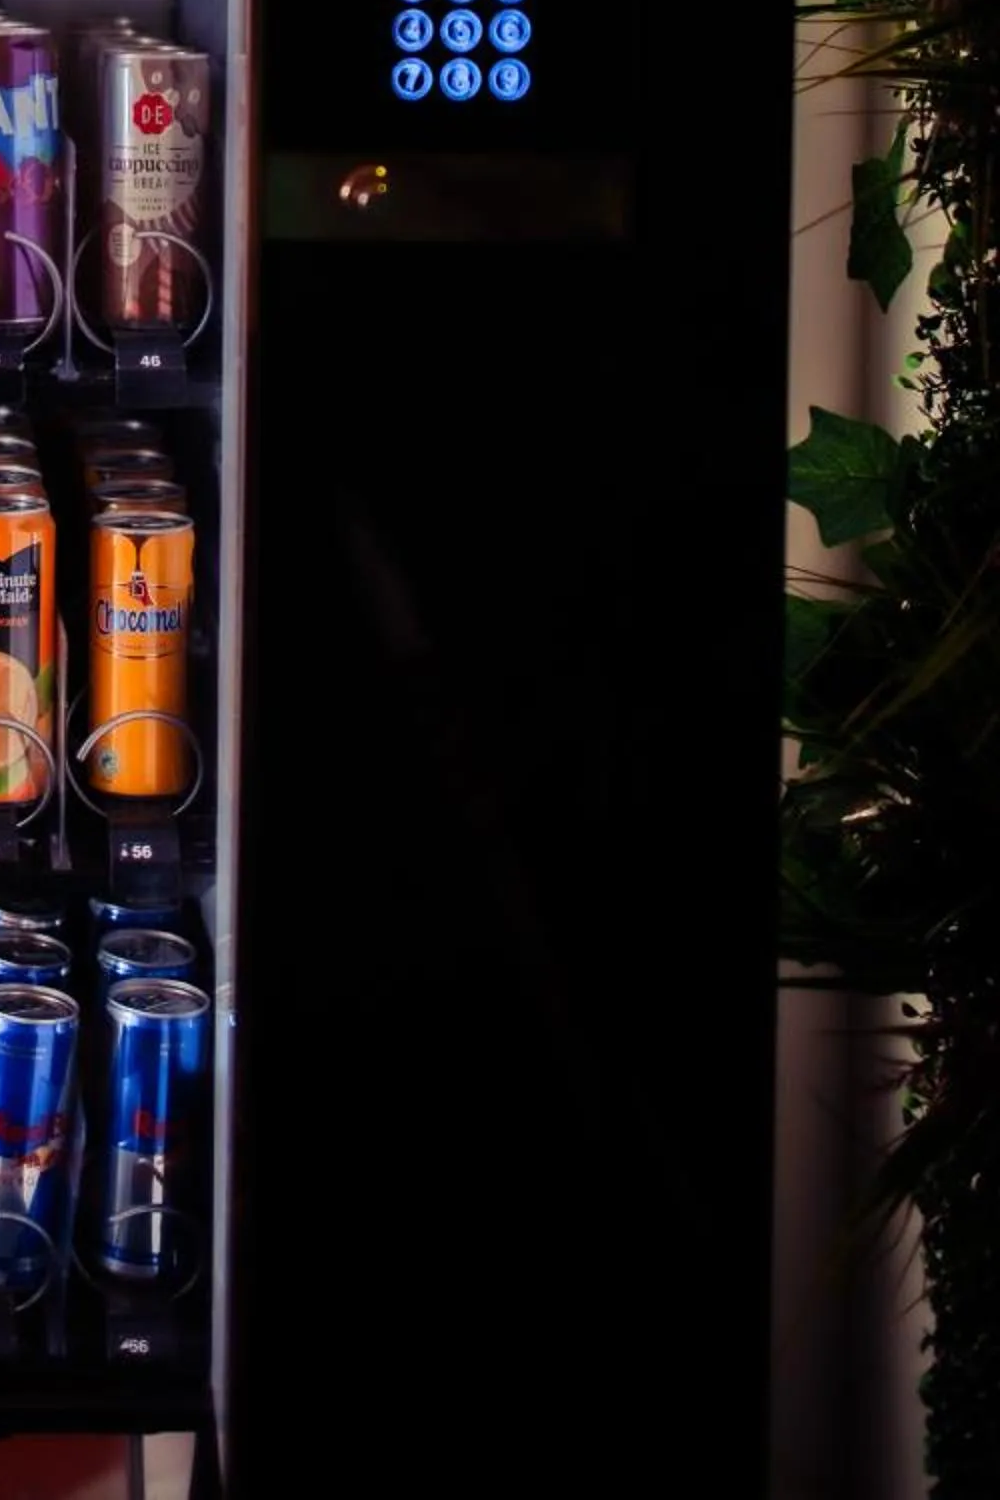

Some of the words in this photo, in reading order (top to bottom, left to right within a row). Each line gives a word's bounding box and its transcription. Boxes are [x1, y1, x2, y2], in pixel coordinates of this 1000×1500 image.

[143, 143, 161, 155] ICE
[140, 355, 162, 367] 46
[95, 598, 183, 634] Chocomel
[131, 845, 153, 859] 56
